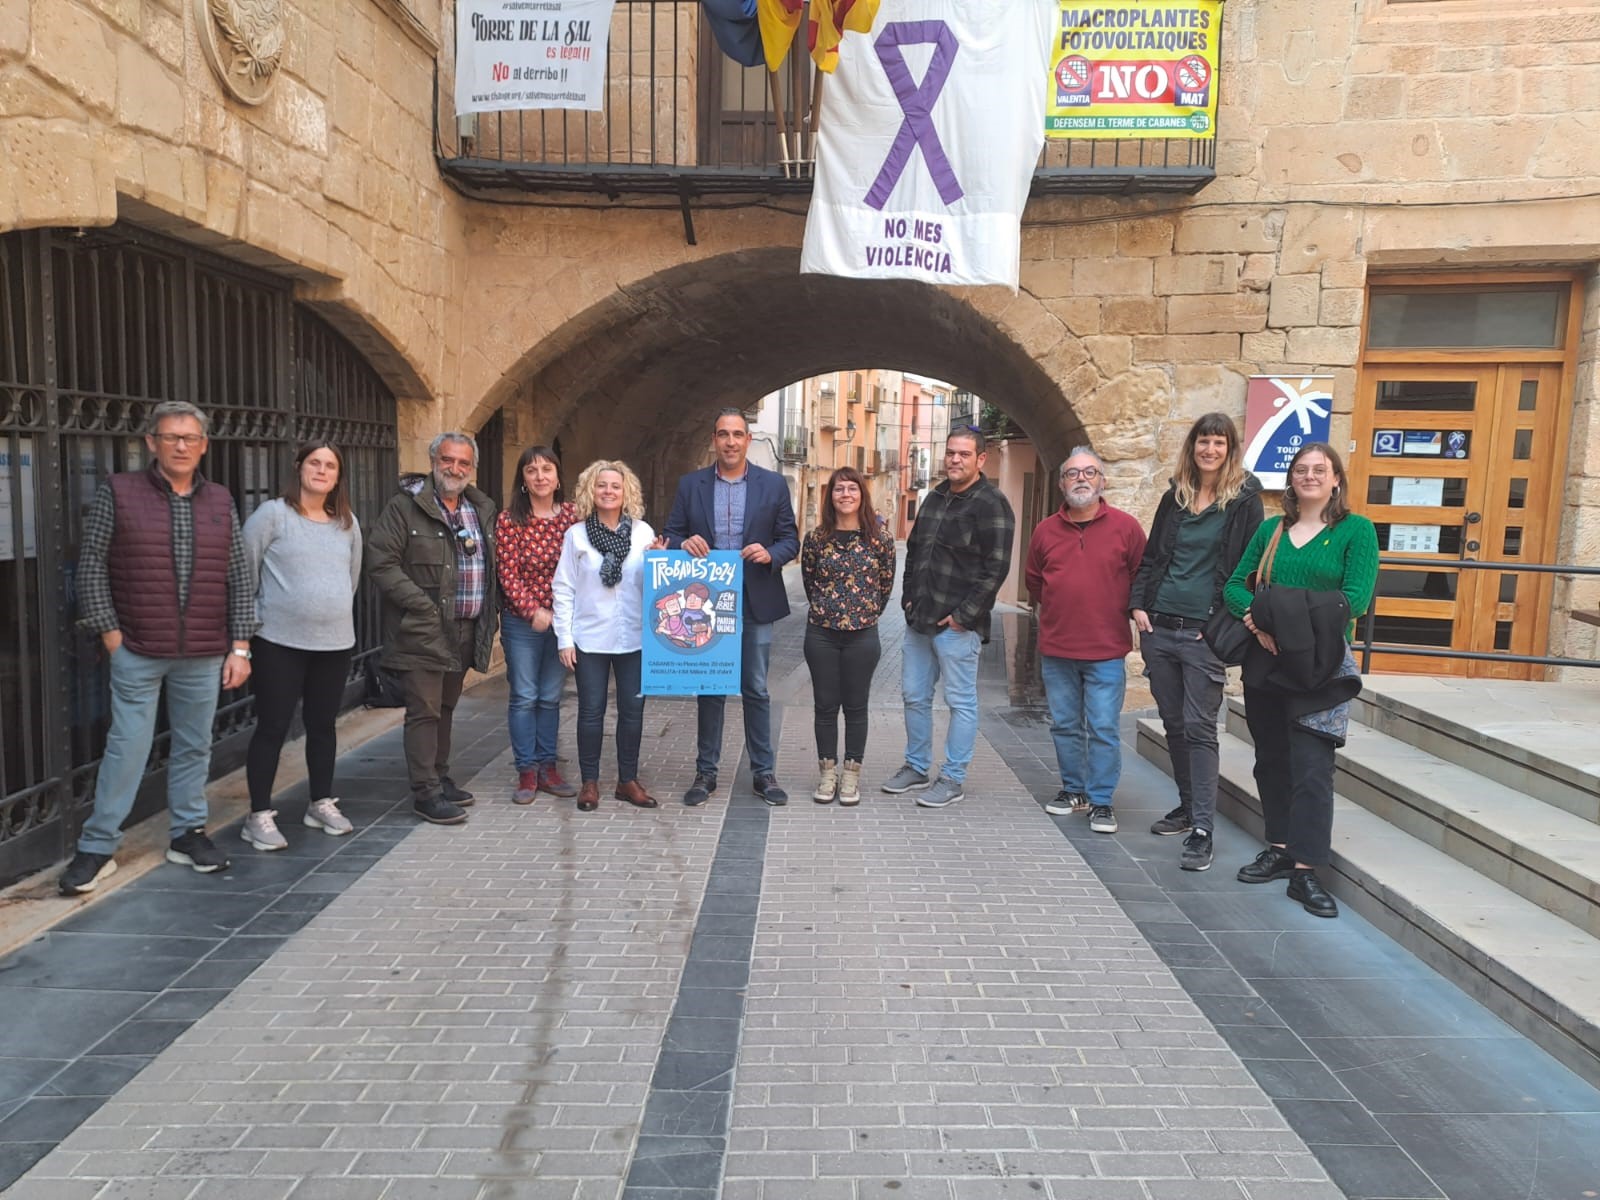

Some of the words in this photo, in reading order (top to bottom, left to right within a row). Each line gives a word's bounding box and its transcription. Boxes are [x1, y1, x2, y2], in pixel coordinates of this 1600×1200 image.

[1061, 9, 1210, 29] MACROPLANTES
[472, 12, 514, 42] TORRE
[519, 20, 538, 41] DE
[542, 20, 559, 41] LA
[564, 20, 592, 46] SAL
[1061, 31, 1207, 51] FOTOVOLTAIQUES
[546, 47, 557, 59] es
[513, 67, 521, 80] al
[1097, 64, 1168, 99] NO
[1057, 95, 1090, 104] VALENTIA
[1181, 92, 1204, 105] MAT
[1054, 117, 1096, 128] DEFENSEM
[1097, 117, 1107, 128] EL
[1108, 117, 1135, 128] TERME
[1136, 117, 1147, 128] DE
[1148, 116, 1186, 128] CABANES
[884, 218, 907, 239] NO
[913, 219, 942, 244] MES
[865, 246, 952, 274] VIOLENCIA
[1277, 446, 1301, 454] TOUR
[648, 557, 707, 590] TROBADES
[708, 561, 737, 585] 2024
[719, 592, 735, 601] FEM
